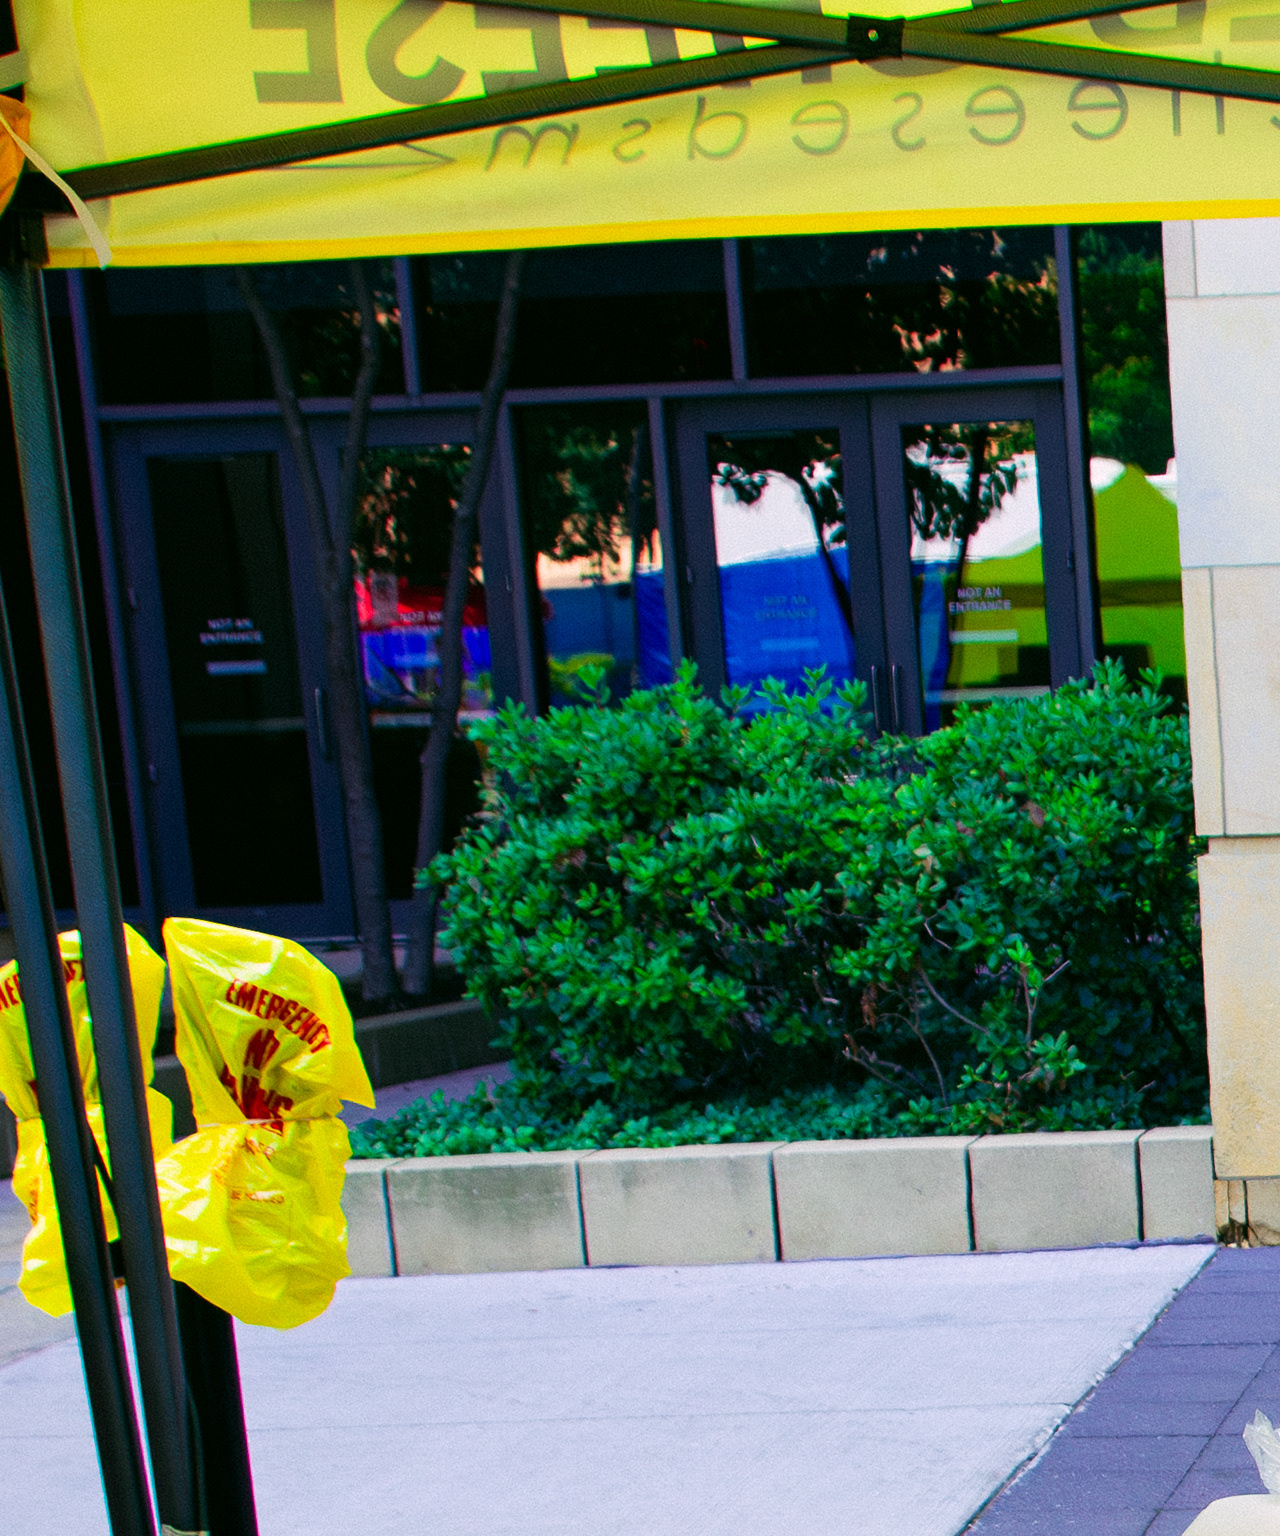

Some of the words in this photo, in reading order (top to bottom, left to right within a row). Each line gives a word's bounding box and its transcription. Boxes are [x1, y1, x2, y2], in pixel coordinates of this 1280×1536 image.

[957, 586, 983, 599] NOT
[984, 586, 1002, 599] AN
[948, 599, 1012, 616] ENTRANCE
[225, 978, 333, 1054] EMERGENCY
